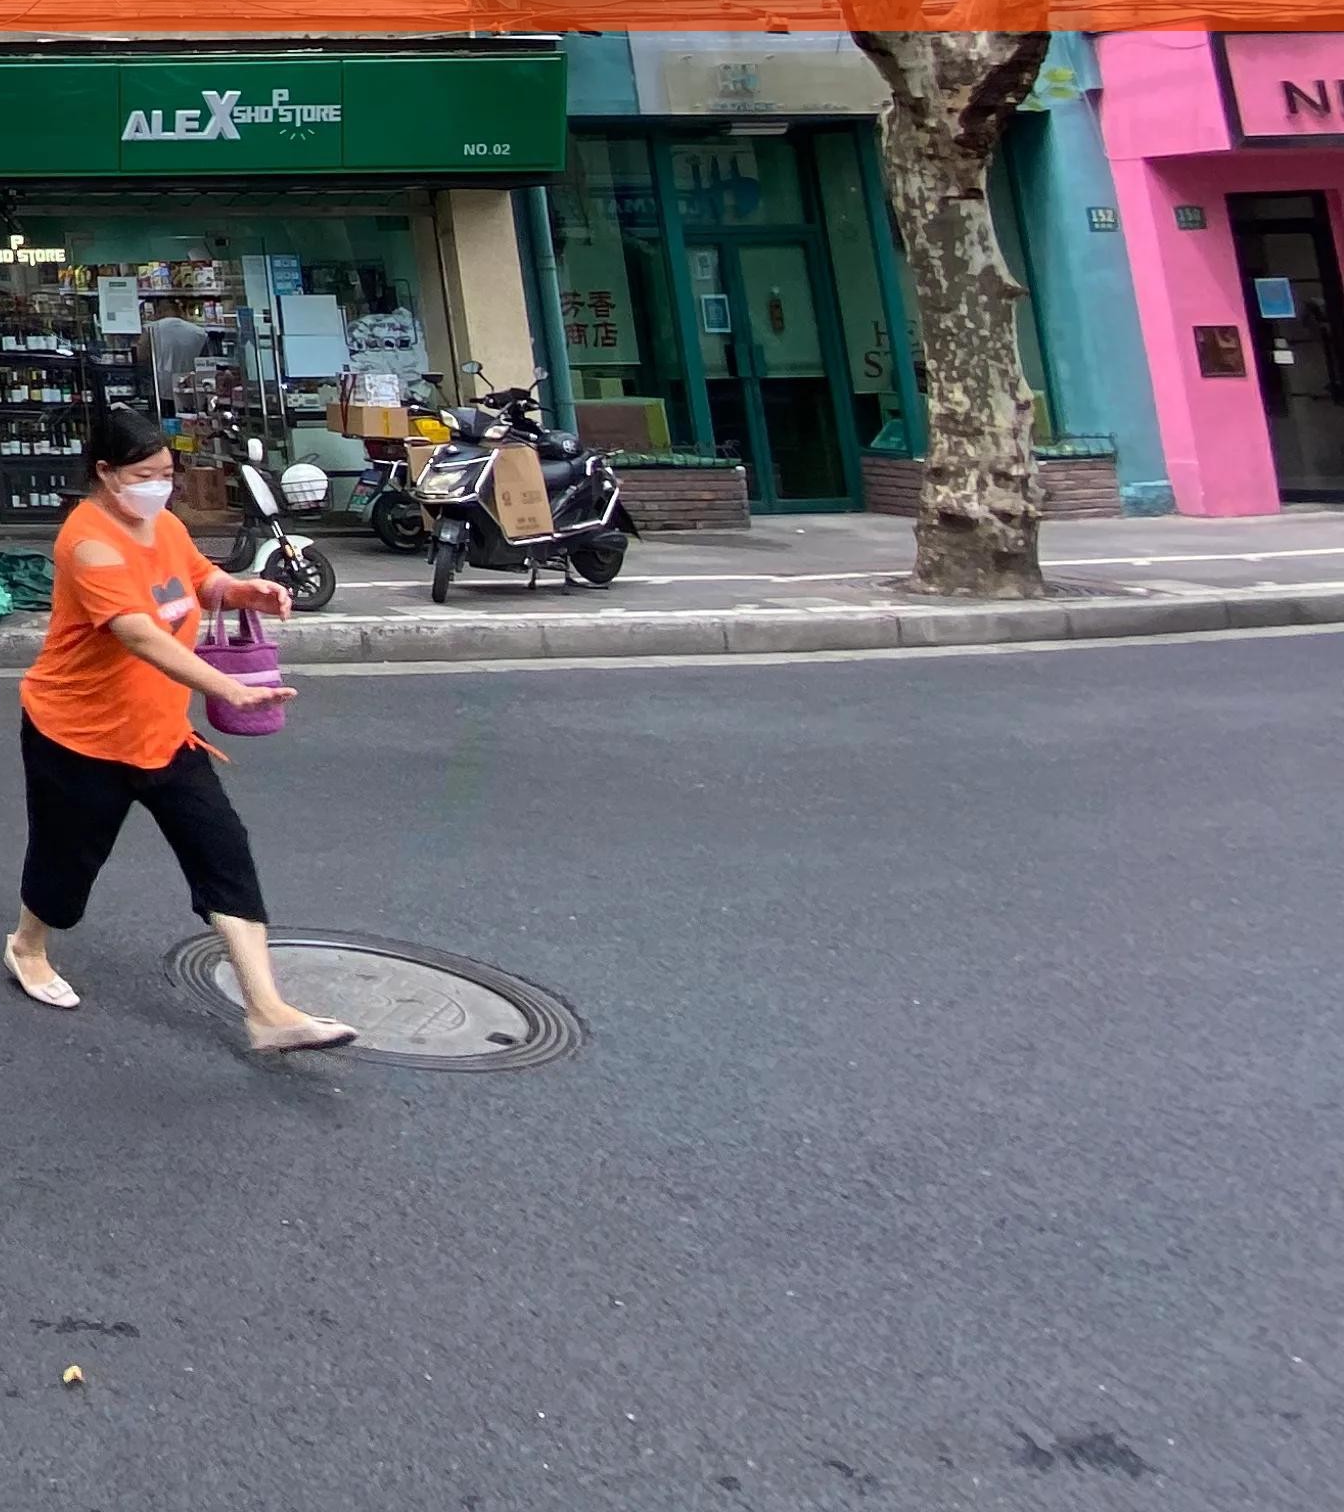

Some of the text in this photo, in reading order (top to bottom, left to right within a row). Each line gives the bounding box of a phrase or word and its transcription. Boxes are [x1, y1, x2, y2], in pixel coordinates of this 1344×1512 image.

[1280, 79, 1344, 114] N
[121, 90, 242, 140] ALEX
[463, 143, 511, 156] NO.02
